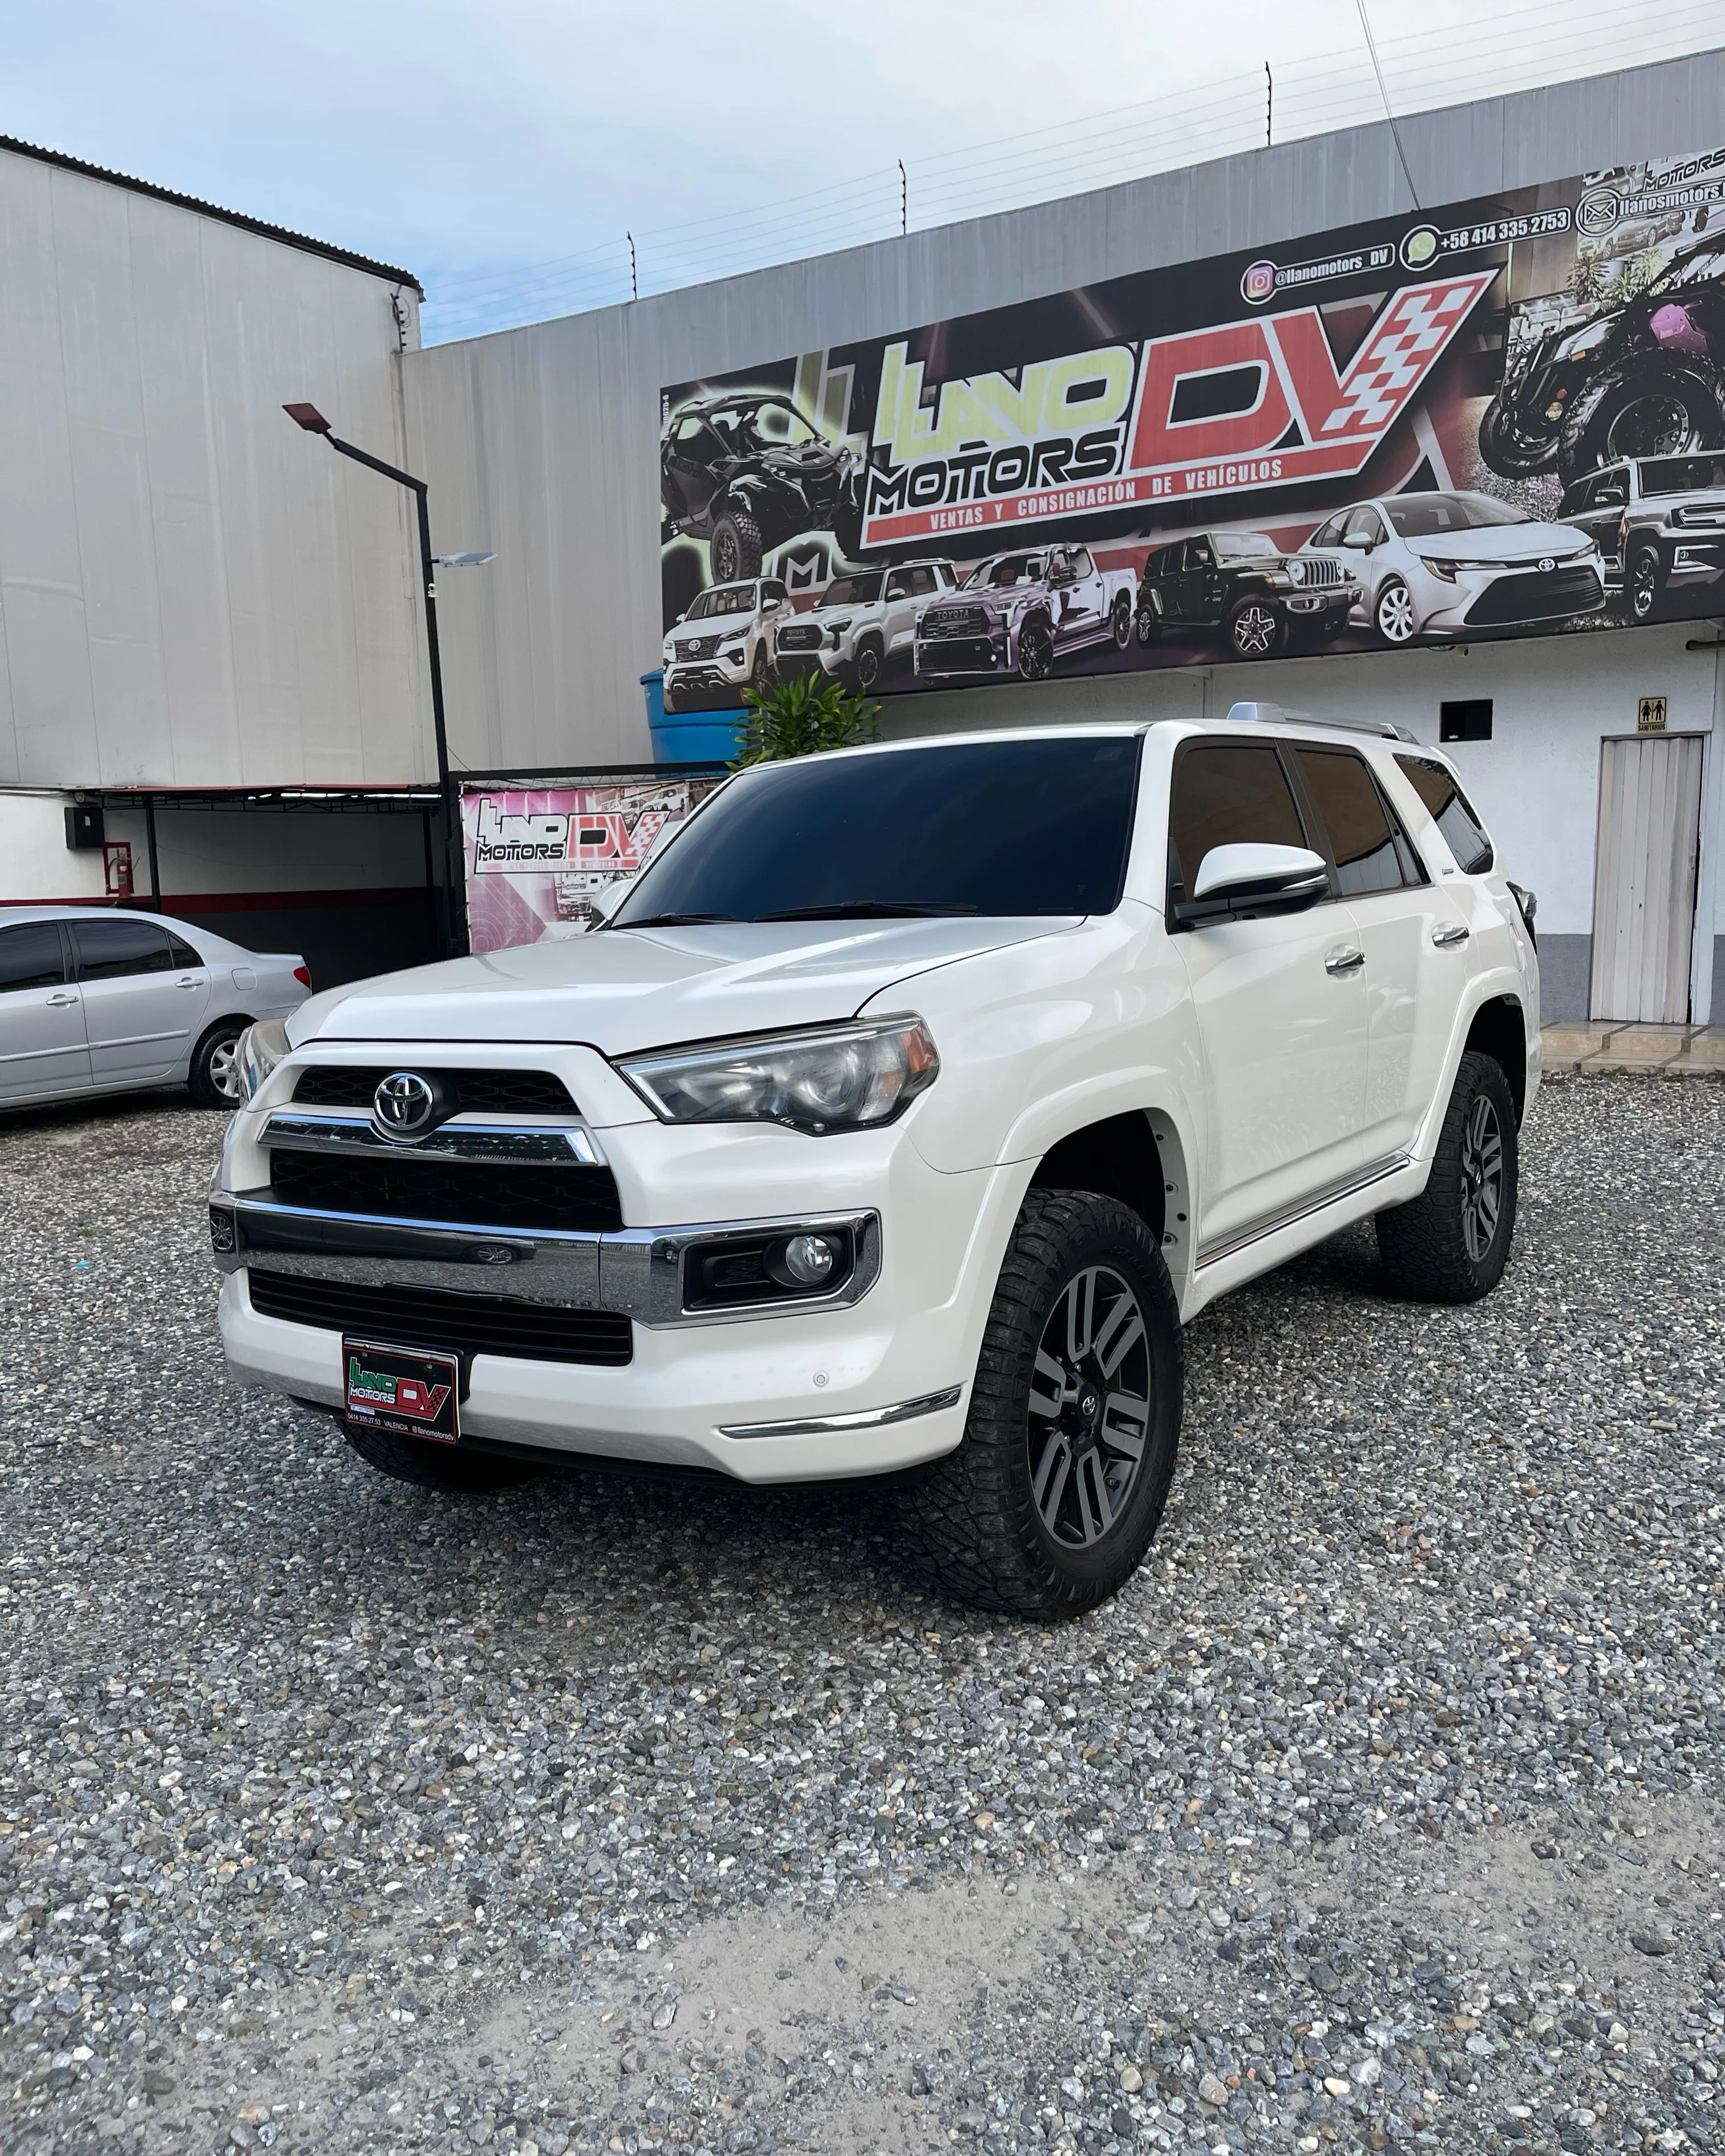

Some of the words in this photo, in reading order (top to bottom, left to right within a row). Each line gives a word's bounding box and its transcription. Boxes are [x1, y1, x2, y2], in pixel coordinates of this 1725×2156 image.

[1643, 148, 1725, 191] MOTORS
[1619, 185, 1719, 216] llanosmotors
[1440, 230, 1469, 249] +58
[1471, 225, 1496, 244] 414
[1530, 211, 1567, 233] 2753
[1129, 271, 1497, 470] DV
[868, 431, 1122, 516] MOTORS
[930, 506, 983, 530] VENTAS
[994, 502, 1004, 521] Y
[1018, 480, 1136, 516] CONSIGNACIÓN
[1152, 476, 1172, 496] DE
[1185, 459, 1282, 492] VEHÍCULOS
[937, 609, 969, 619] TOYOTA
[478, 842, 564, 861] MOTORS
[568, 811, 670, 858] DV
[350, 1387, 395, 1404] MOTORS
[396, 1377, 451, 1412] DV
[383, 1420, 408, 1431] VALENCIA
